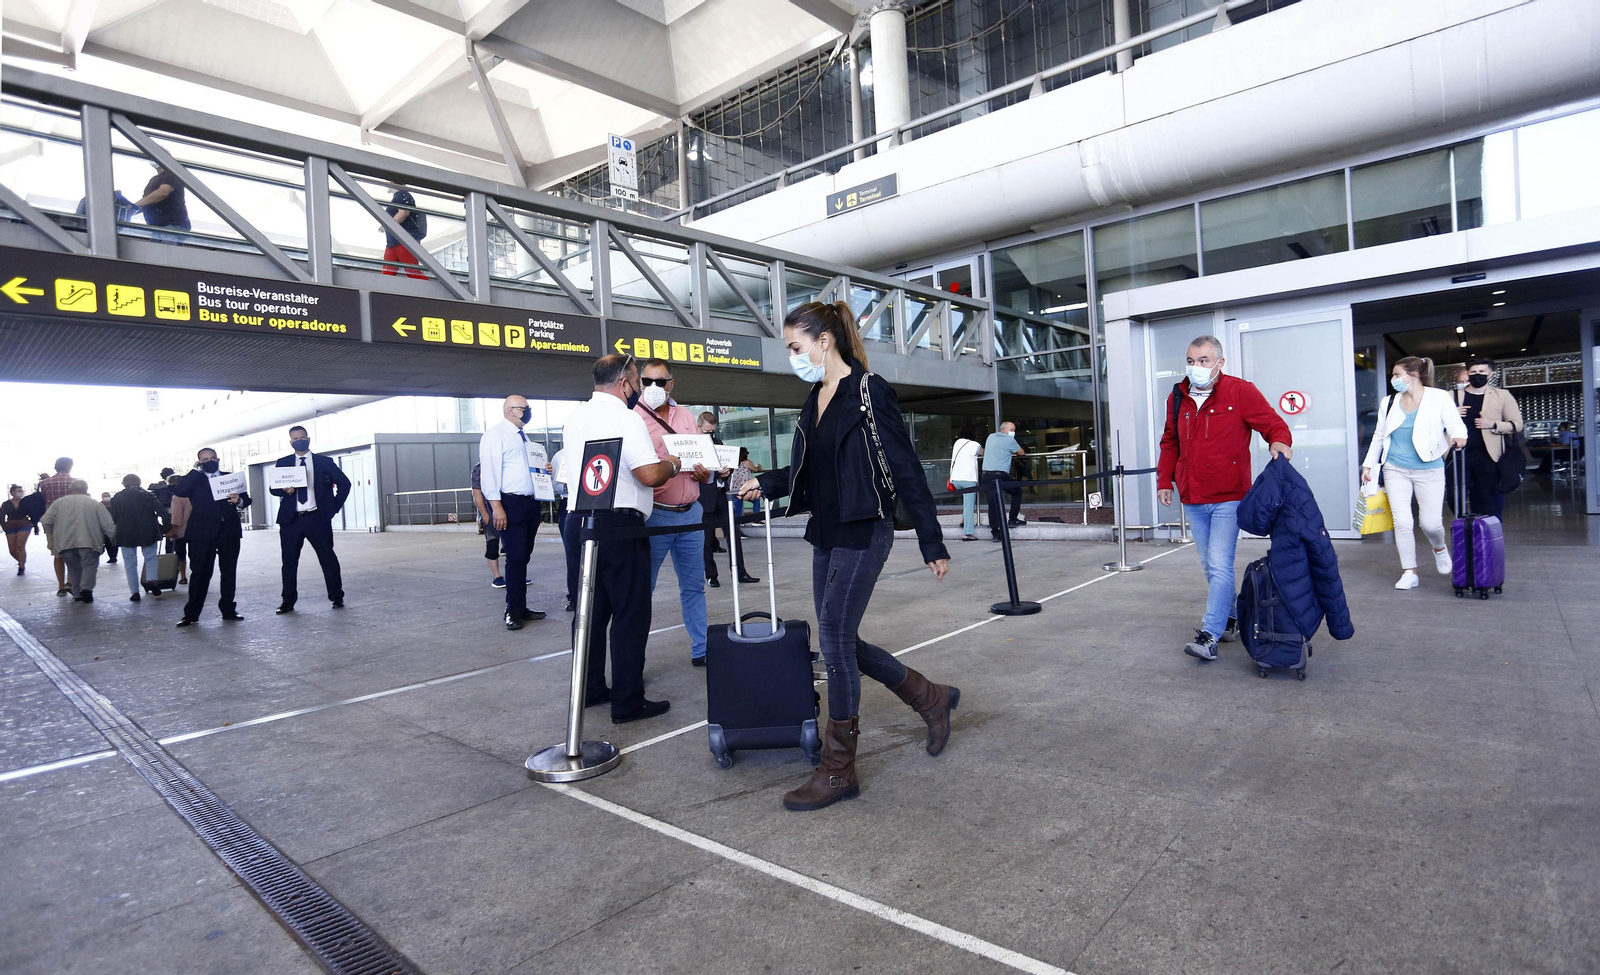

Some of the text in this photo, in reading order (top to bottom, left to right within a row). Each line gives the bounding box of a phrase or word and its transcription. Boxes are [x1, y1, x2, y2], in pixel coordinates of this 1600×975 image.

[615, 188, 626, 196] 100
[859, 186, 877, 196] Terminal
[859, 191, 881, 203] Terminal
[197, 281, 319, 305] Busreise-Veranstalter
[198, 295, 308, 316] Bus tour operators
[198, 308, 347, 333] Bus tour operadores
[528, 318, 564, 330] Parkplätze
[529, 328, 555, 340] Parking
[530, 338, 590, 353] Aparcamiento
[706, 337, 732, 347] Autoverleih
[706, 346, 729, 355] Car rental
[707, 355, 730, 365] Alquiler
[739, 358, 760, 367] coches
[674, 439, 698, 447] HARRY
[678, 451, 704, 460] RUMES
[220, 477, 238, 486] Nicole
[217, 483, 244, 495] Fitzgerald
